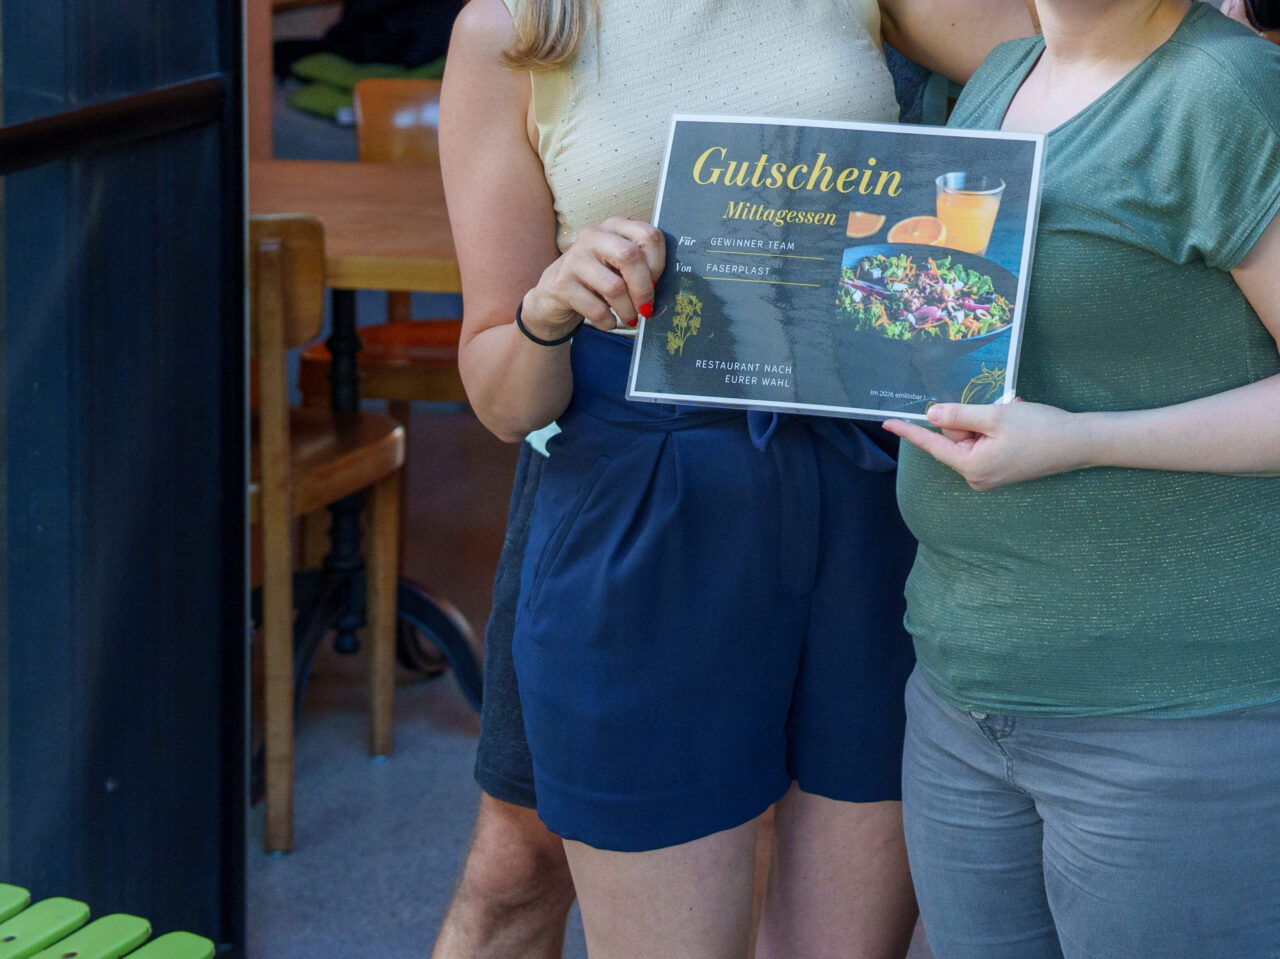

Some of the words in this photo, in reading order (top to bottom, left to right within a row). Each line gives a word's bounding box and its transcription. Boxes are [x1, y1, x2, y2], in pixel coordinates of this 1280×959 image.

[692, 146, 903, 197] Gutschein
[722, 200, 837, 227] Mittagessen
[678, 235, 697, 246] Für
[710, 237, 764, 249] GEWINNER
[768, 240, 795, 251] TEAM
[675, 262, 692, 273] Von
[706, 263, 771, 276] FASERPLAST
[695, 359, 760, 372] RESTAURANT
[764, 364, 792, 375] NACH
[725, 374, 758, 385] EURER
[761, 377, 790, 388] WAHL
[880, 390, 894, 398] 2026
[894, 392, 922, 400] einlösbar
